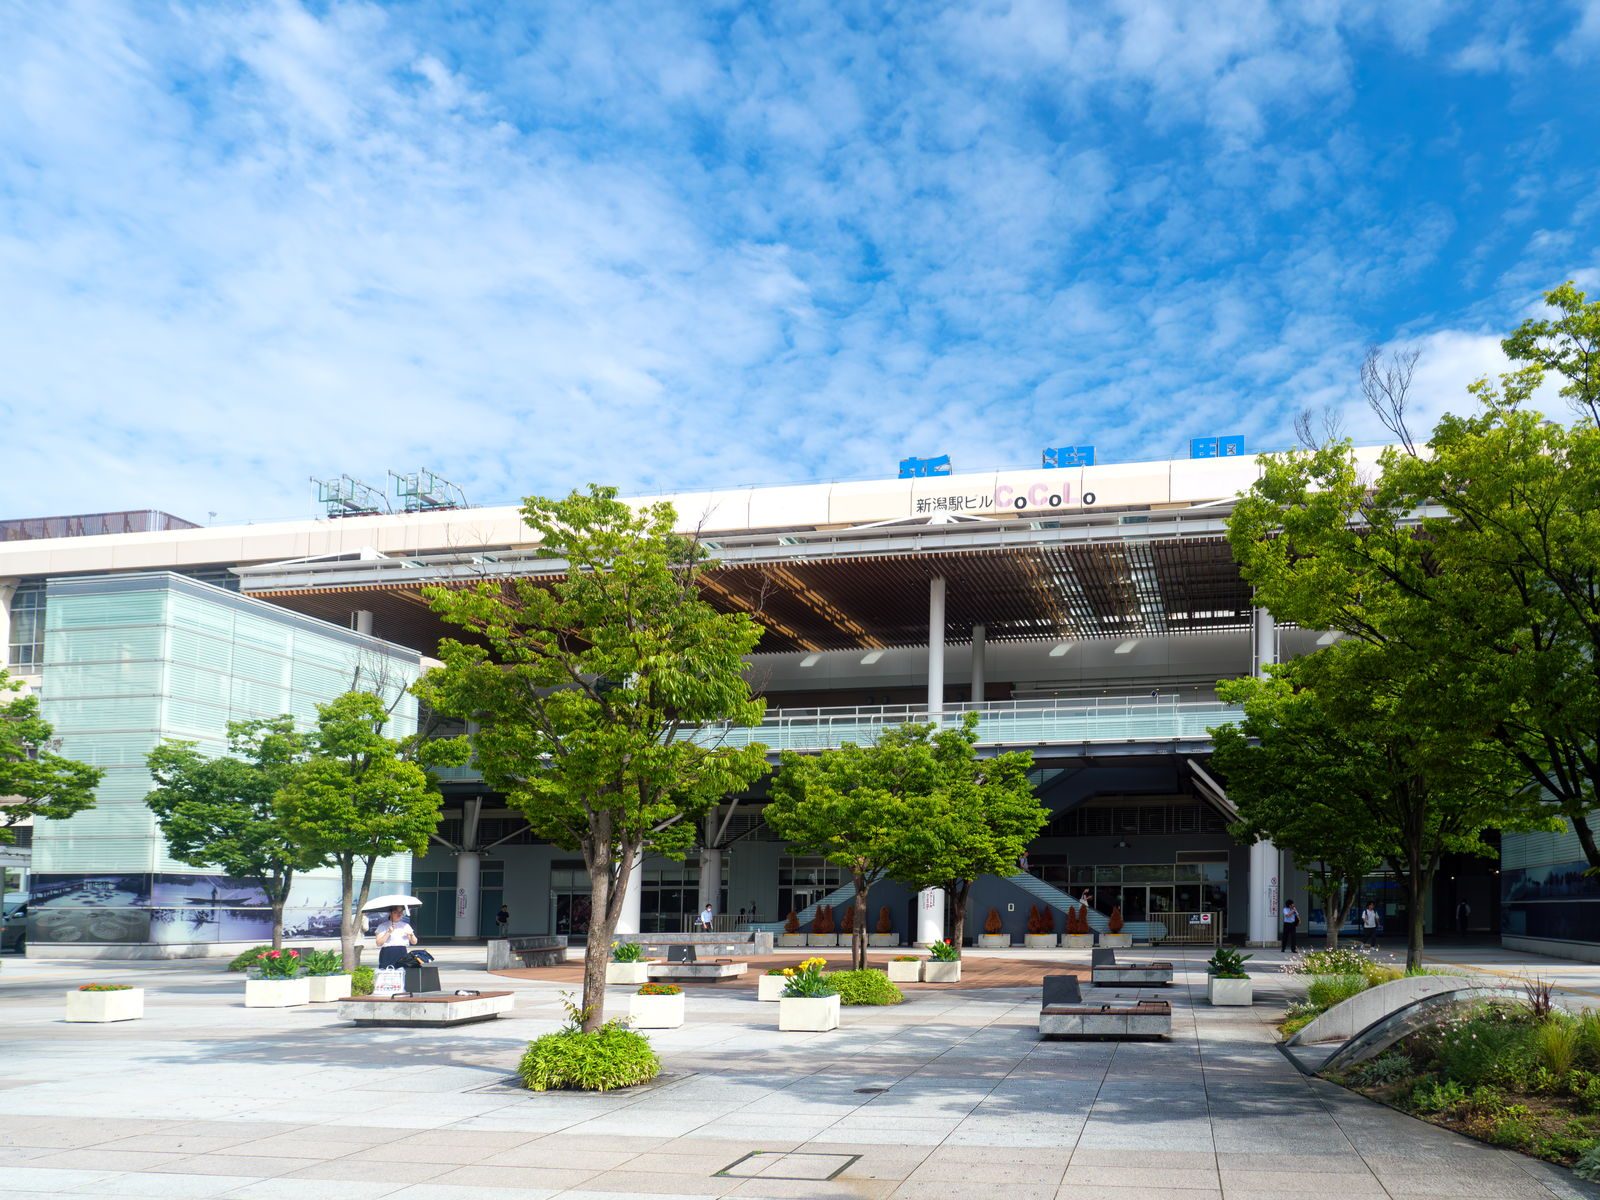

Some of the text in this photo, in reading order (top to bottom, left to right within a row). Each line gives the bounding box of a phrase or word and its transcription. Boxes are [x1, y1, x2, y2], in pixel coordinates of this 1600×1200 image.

[916, 495, 993, 514] 新潟駅ビル
